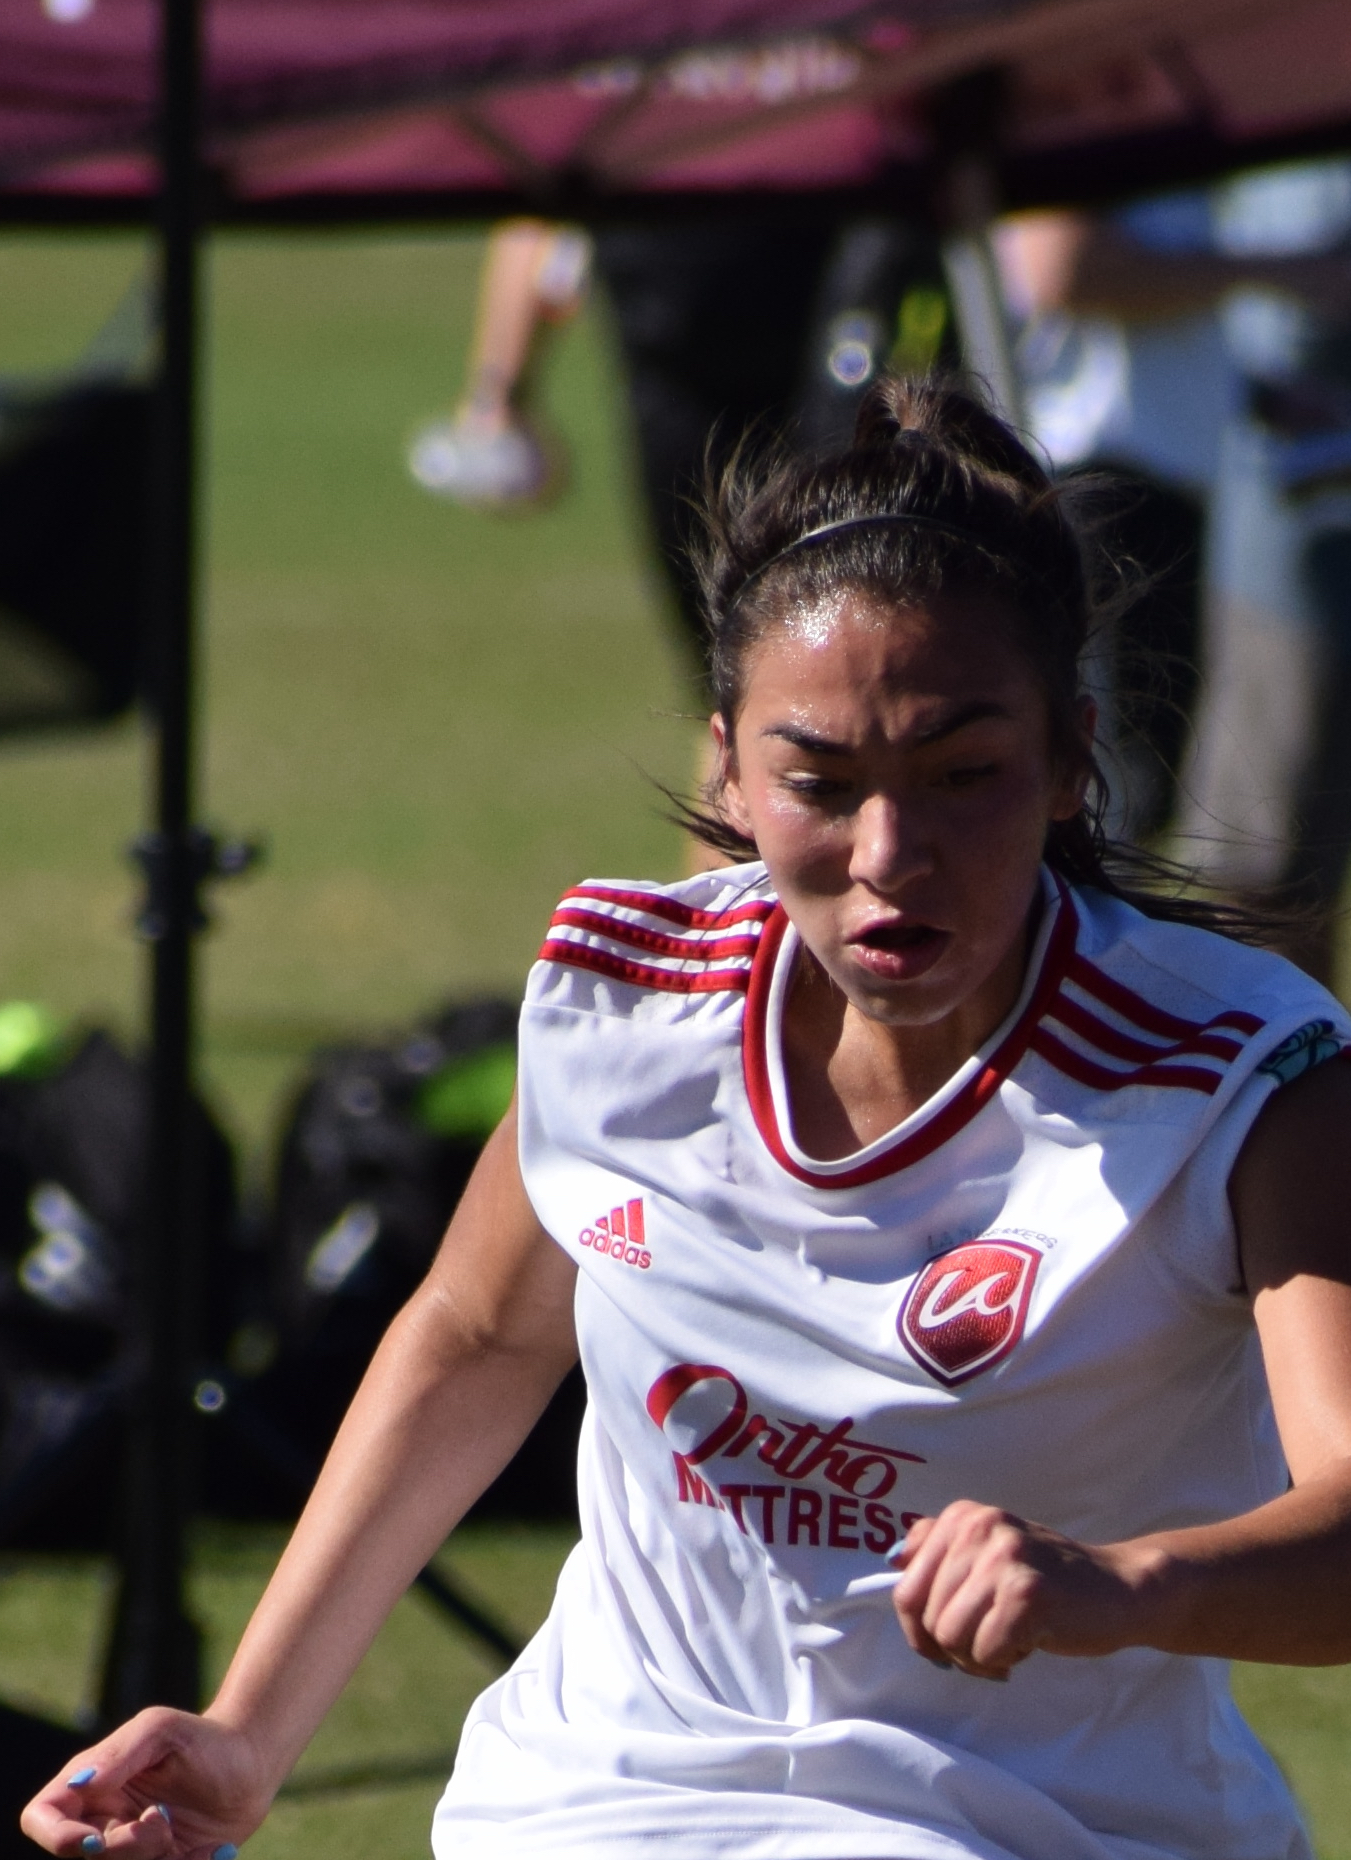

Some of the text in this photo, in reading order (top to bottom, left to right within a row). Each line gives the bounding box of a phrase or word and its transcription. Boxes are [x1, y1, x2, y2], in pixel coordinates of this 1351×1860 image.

[578, 1228, 652, 1269] adidas
[646, 1363, 927, 1500] Ortho
[672, 1451, 930, 1554] MTTRES
